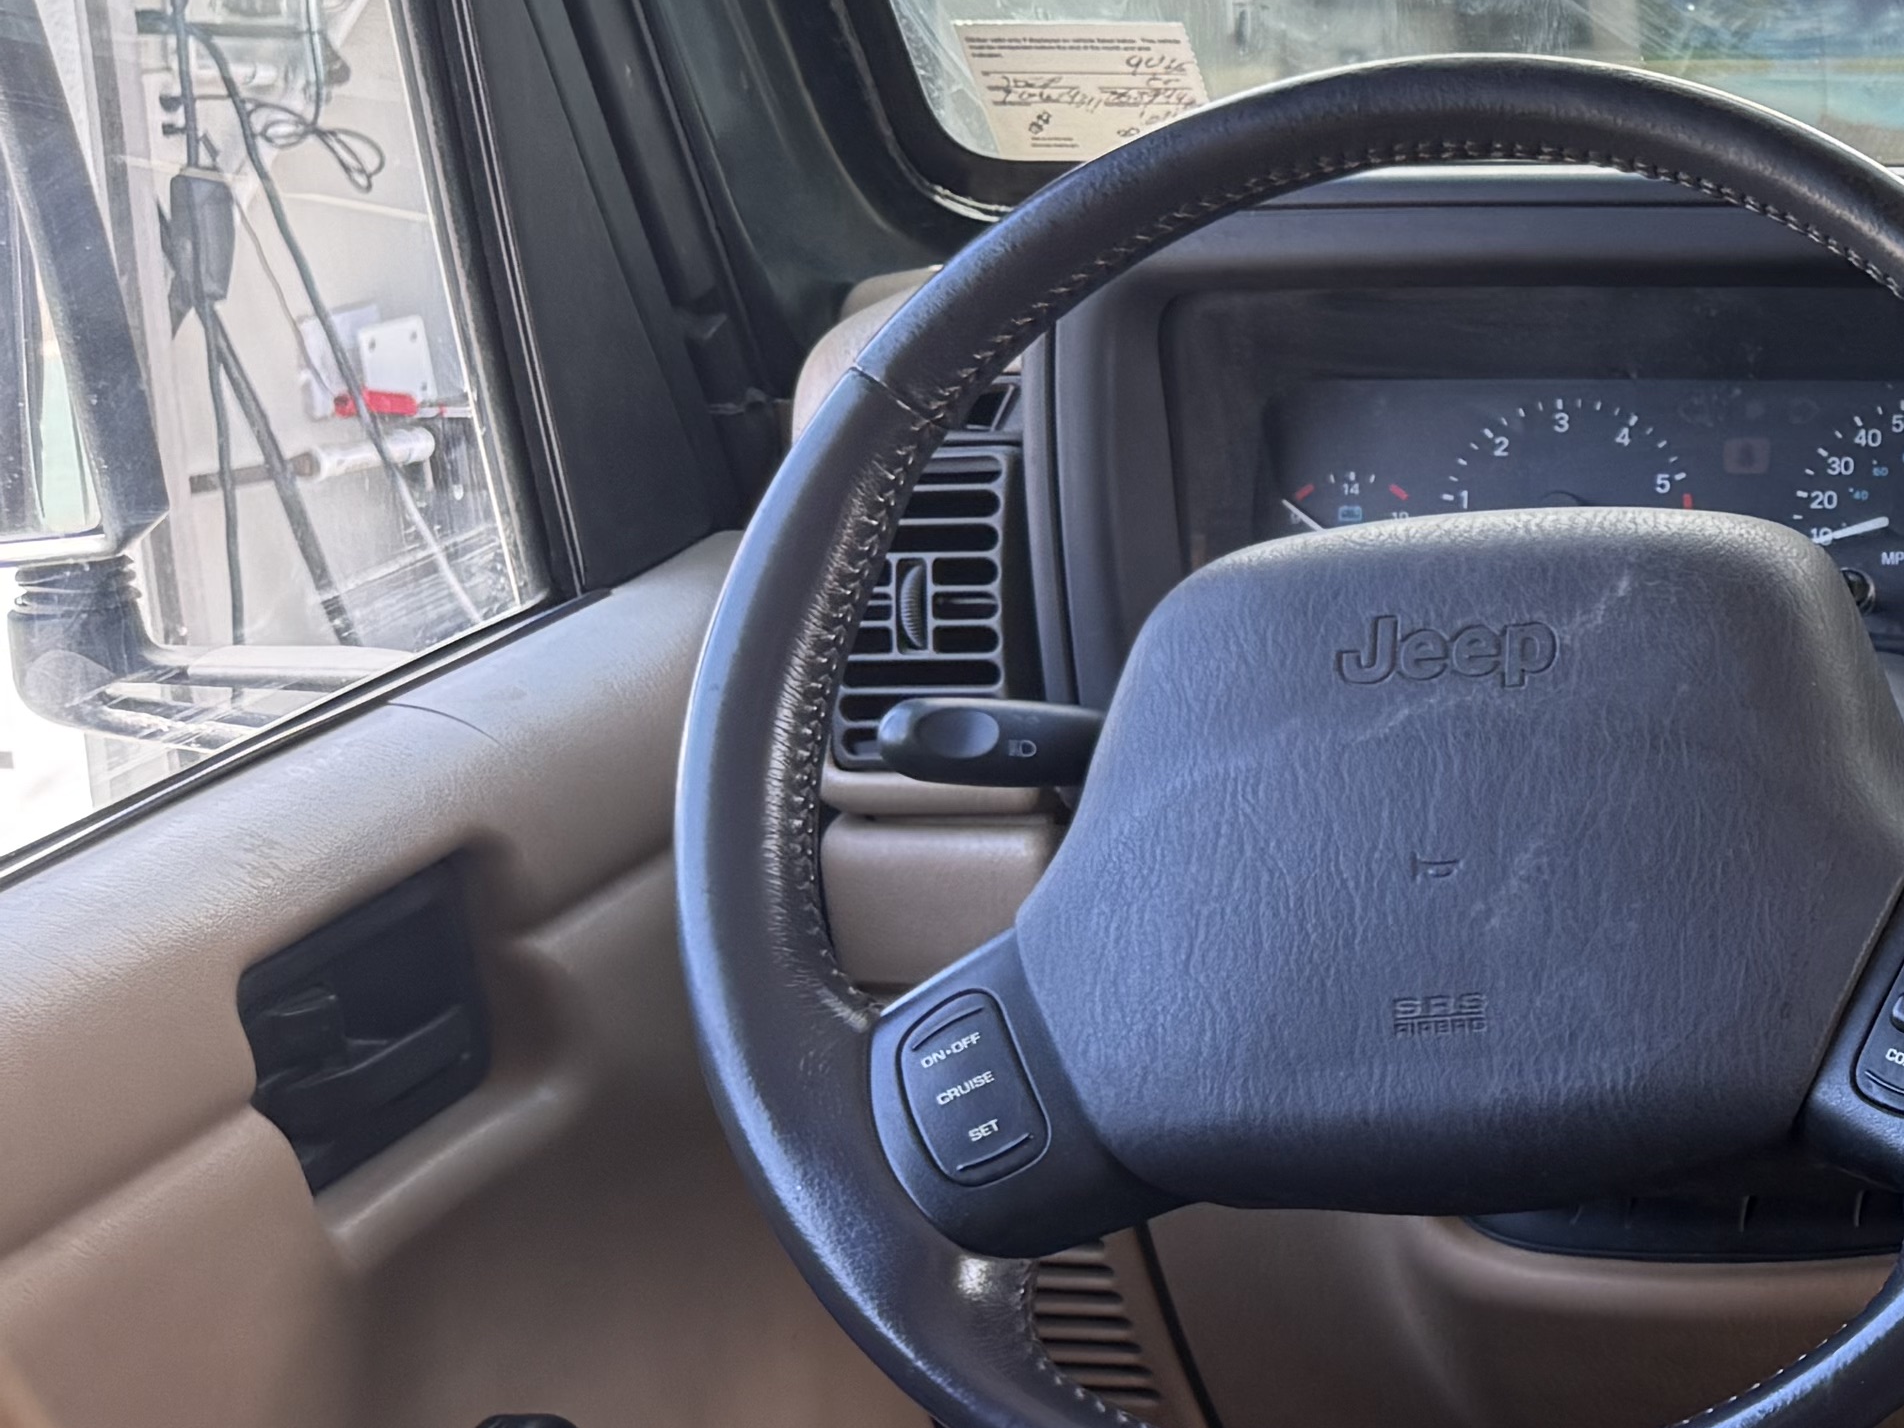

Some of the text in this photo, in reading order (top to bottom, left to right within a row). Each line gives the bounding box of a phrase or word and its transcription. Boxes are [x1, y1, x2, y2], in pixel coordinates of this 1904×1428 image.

[1553, 413, 1569, 432] 3
[1493, 436, 1509, 456] 2
[1615, 427, 1631, 447] 4
[1854, 429, 1882, 447] 40
[1827, 457, 1854, 475] 30
[1343, 483, 1359, 495] 14
[1655, 474, 1670, 493] 5
[1460, 490, 1468, 508] 1
[1810, 491, 1837, 509] 20
[1853, 491, 1868, 501] 40
[1336, 614, 1558, 688] Jeep
[1393, 993, 1487, 1017] SRS
[1393, 1017, 1488, 1036] AIRBAG
[936, 1071, 994, 1106] CRUISE
[968, 1119, 1000, 1142] SET
